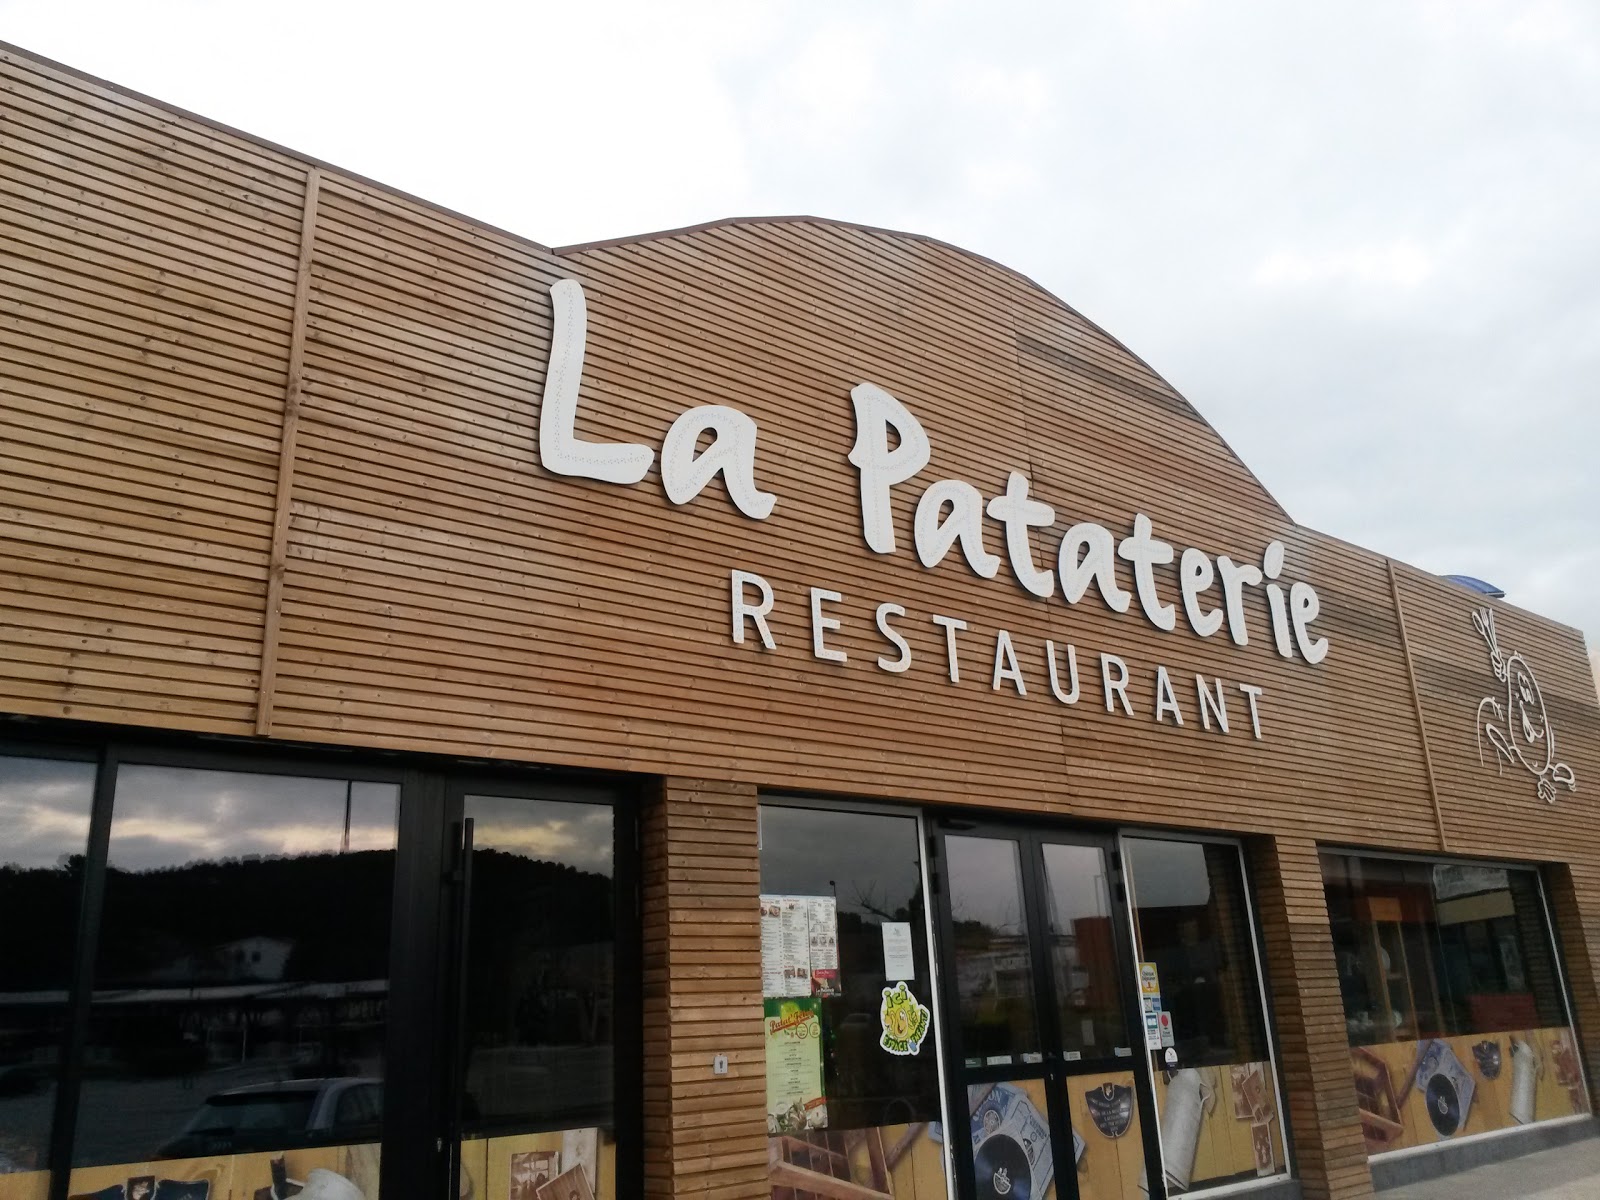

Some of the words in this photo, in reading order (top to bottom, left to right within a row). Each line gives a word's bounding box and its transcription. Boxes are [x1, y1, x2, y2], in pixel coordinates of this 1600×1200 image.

[537, 278, 778, 521] La
[847, 382, 1330, 665] Pataterie
[730, 568, 1265, 740] RESTAURANT
[883, 1034, 909, 1052] ESPACE
